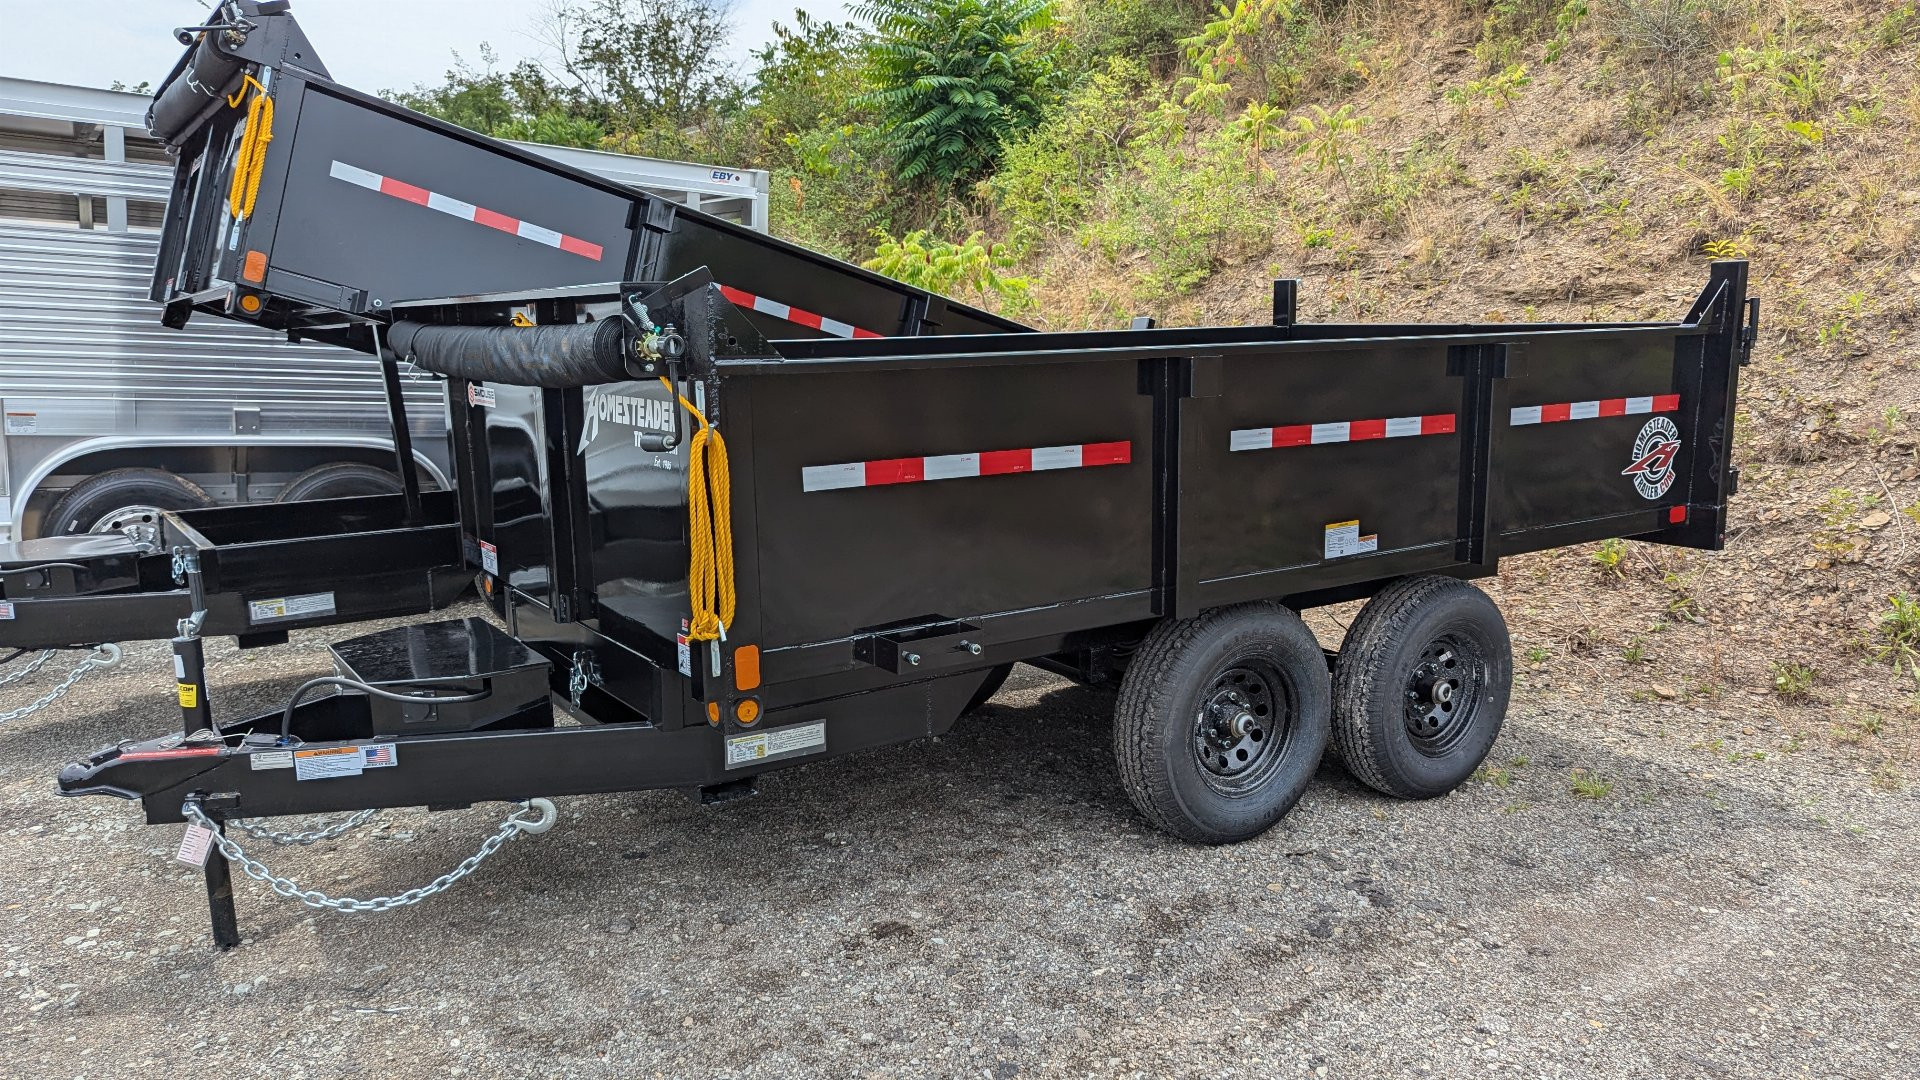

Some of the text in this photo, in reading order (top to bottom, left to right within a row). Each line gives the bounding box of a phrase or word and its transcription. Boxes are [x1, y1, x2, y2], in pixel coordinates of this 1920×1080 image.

[712, 170, 734, 181] EBY
[1633, 417, 1677, 460] HOMESTEADER
[1635, 471, 1676, 499] TRAILER.COM
